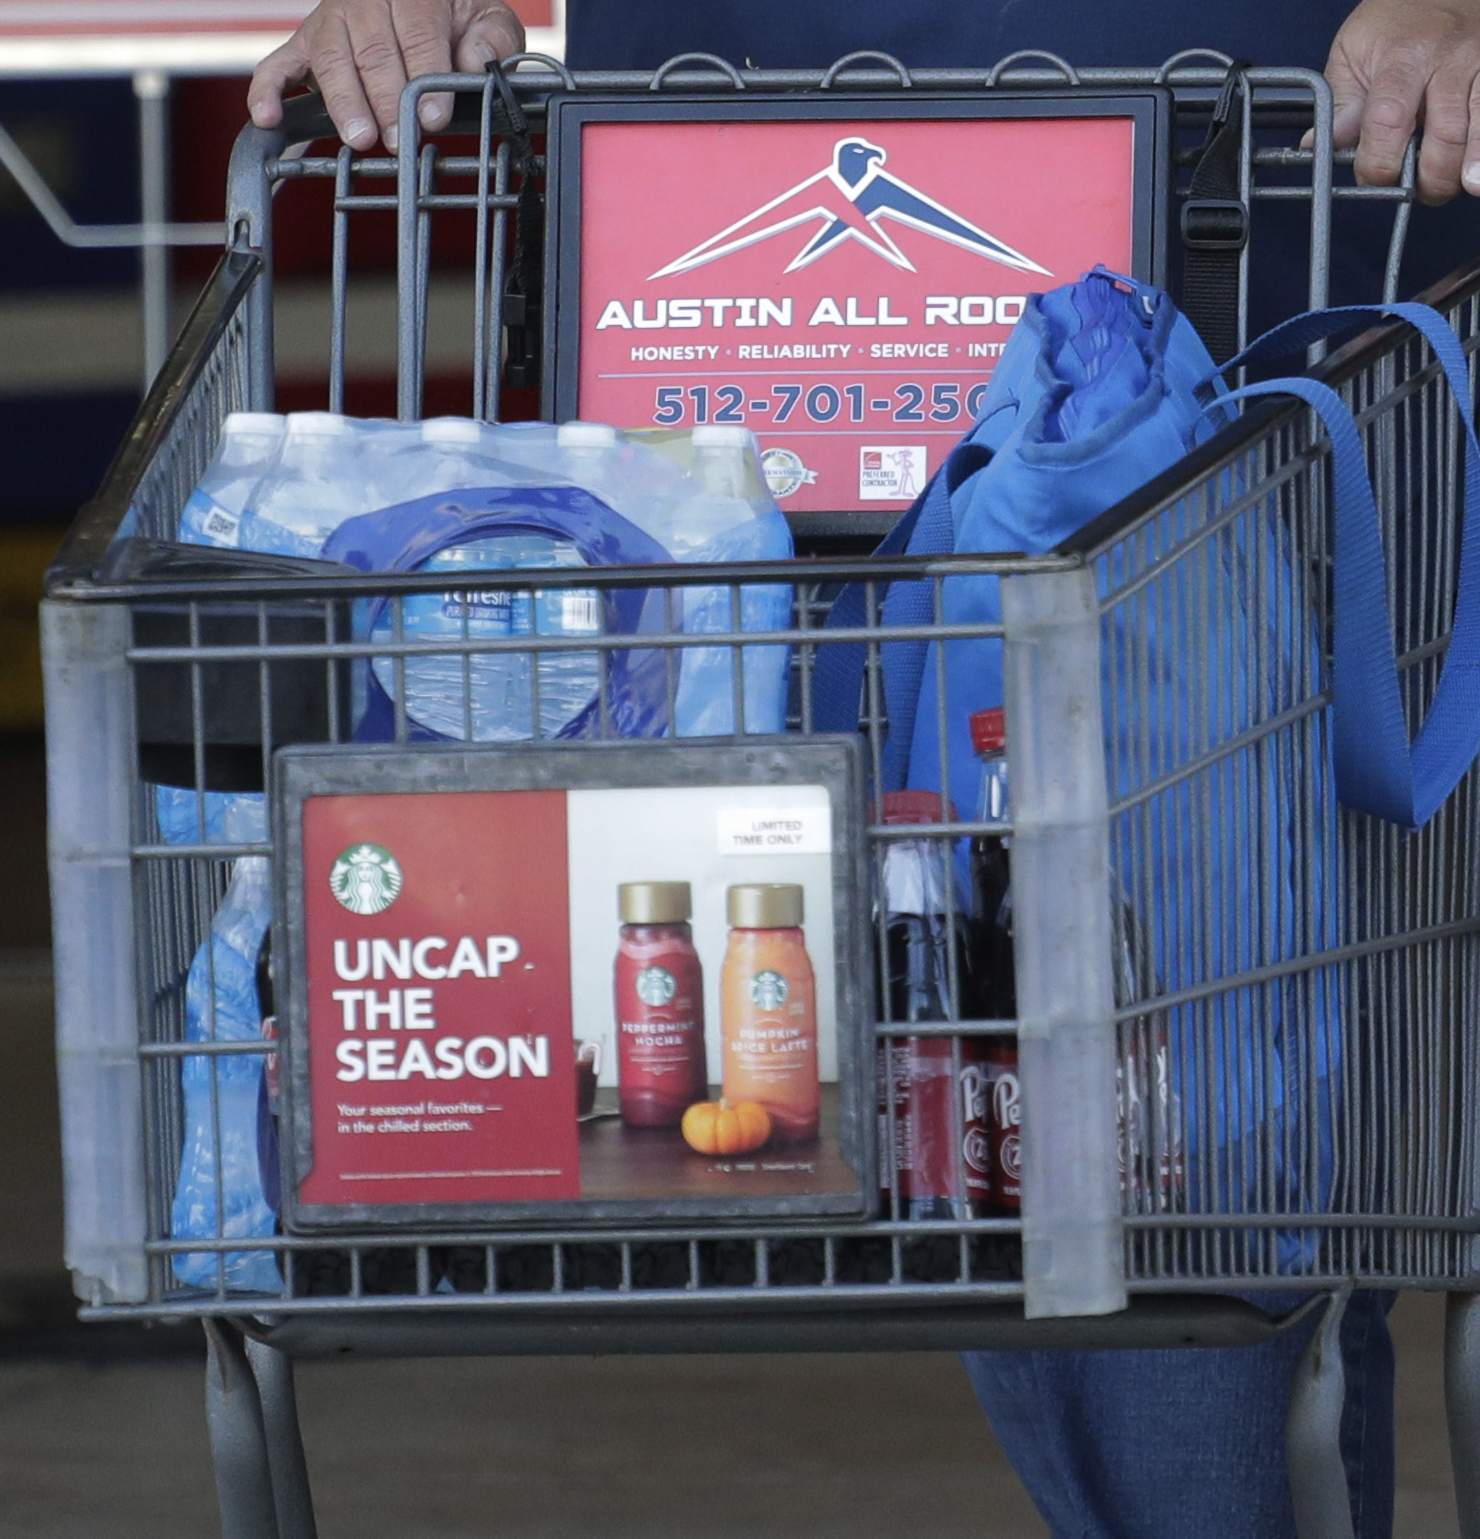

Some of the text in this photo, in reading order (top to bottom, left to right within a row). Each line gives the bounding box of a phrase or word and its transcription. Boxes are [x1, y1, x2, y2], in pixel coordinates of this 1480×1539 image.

[596, 295, 1027, 330] AUSTIN ALL ROO
[630, 345, 720, 362] HONESTY
[737, 343, 852, 360] RELIABILITY
[869, 343, 949, 359] SERVICE
[751, 820, 803, 832] LIMITED
[732, 834, 803, 846] TIME ONLY
[333, 935, 521, 982] UNCAP
[332, 987, 436, 1031] THE
[634, 1035, 684, 1047] MOCHA
[738, 1028, 802, 1040] PUMPKIN
[731, 1040, 809, 1053] SPICE LATTE
[335, 1034, 551, 1082] SEASON
[337, 1101, 485, 1116] Your seasonal favorites
[337, 1119, 473, 1134] in the chilled section.
